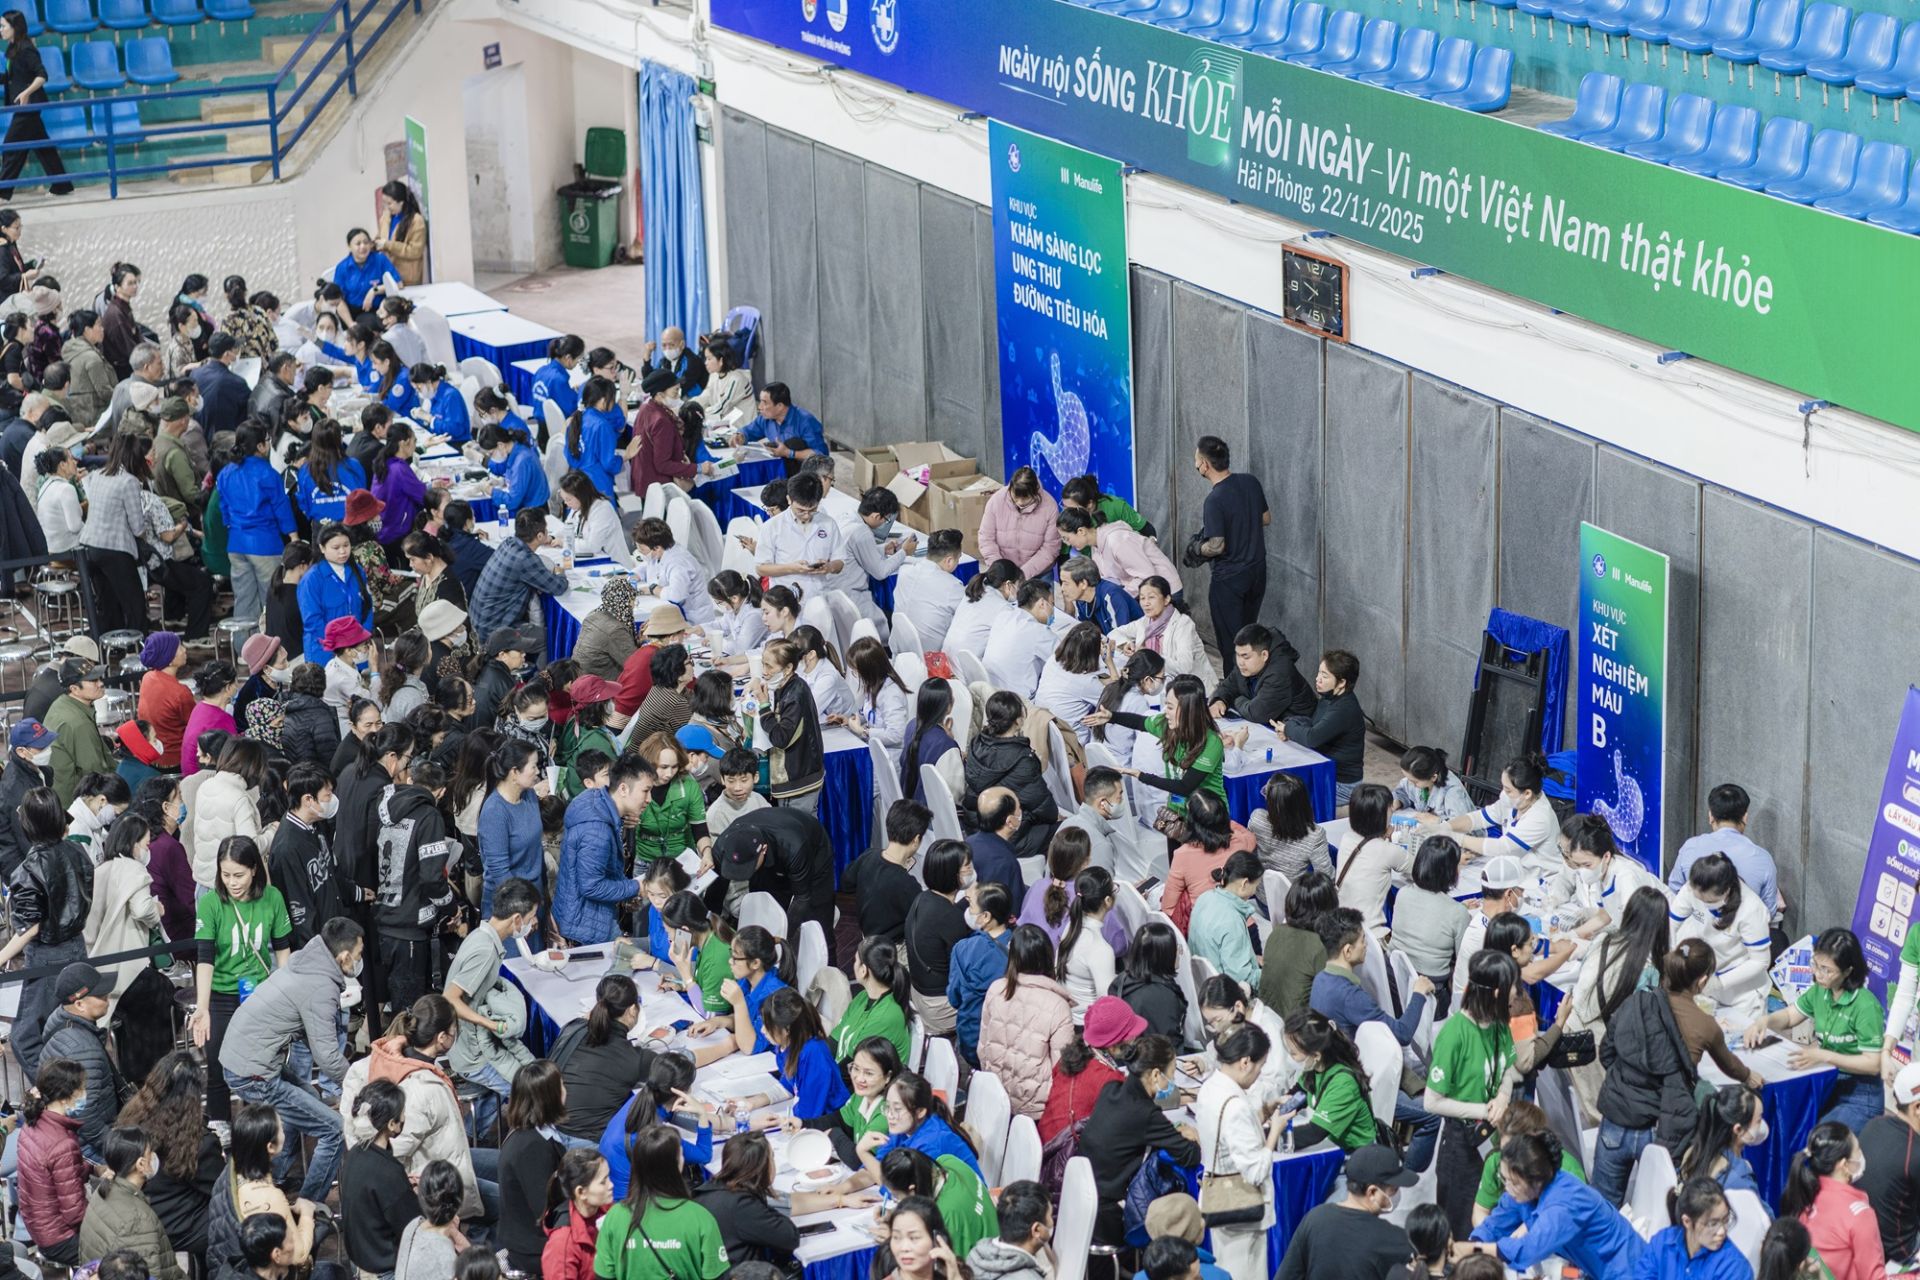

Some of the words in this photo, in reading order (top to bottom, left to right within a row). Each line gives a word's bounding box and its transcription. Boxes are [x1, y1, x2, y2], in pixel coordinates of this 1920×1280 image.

[999, 45, 1040, 83] NGÀY
[1042, 58, 1070, 97] HỘI
[1073, 46, 1136, 112] SỐNG
[1141, 59, 1236, 143] KHỎE
[1241, 97, 1292, 161] MỖI
[1297, 123, 1374, 184] NGÀY
[1388, 148, 1410, 199] Vì
[1417, 167, 1472, 224] một
[1480, 175, 1533, 243] Việt
[1539, 194, 1610, 263] Nam
[1619, 222, 1686, 292] thật
[1692, 240, 1773, 314] khỏe
[1074, 172, 1102, 194] Manulife
[1009, 196, 1023, 215] KHU
[1022, 202, 1037, 220] VỰC
[1238, 158, 1263, 191] Hải
[1265, 167, 1316, 214] Phòng,
[1320, 184, 1424, 244] 22/11/2025
[1010, 221, 1043, 252] KHÁM
[1046, 231, 1077, 265] SÀNG
[1079, 246, 1102, 276] LỌC
[1012, 252, 1037, 280] UNG
[1037, 264, 1061, 290] THƯ
[1013, 282, 1053, 318] ĐƯỜNG
[1054, 298, 1080, 328] TIÊU
[1083, 309, 1108, 341] HÓA
[1624, 573, 1652, 594] Manulife
[1592, 599, 1610, 618] KHU
[1610, 606, 1627, 625] VỰC
[1592, 622, 1618, 651] XÉT
[1592, 653, 1648, 697] NGHIỆM
[1592, 683, 1622, 716] MÁU
[1592, 713, 1607, 748] B
[643, 1238, 681, 1249] Manulife
